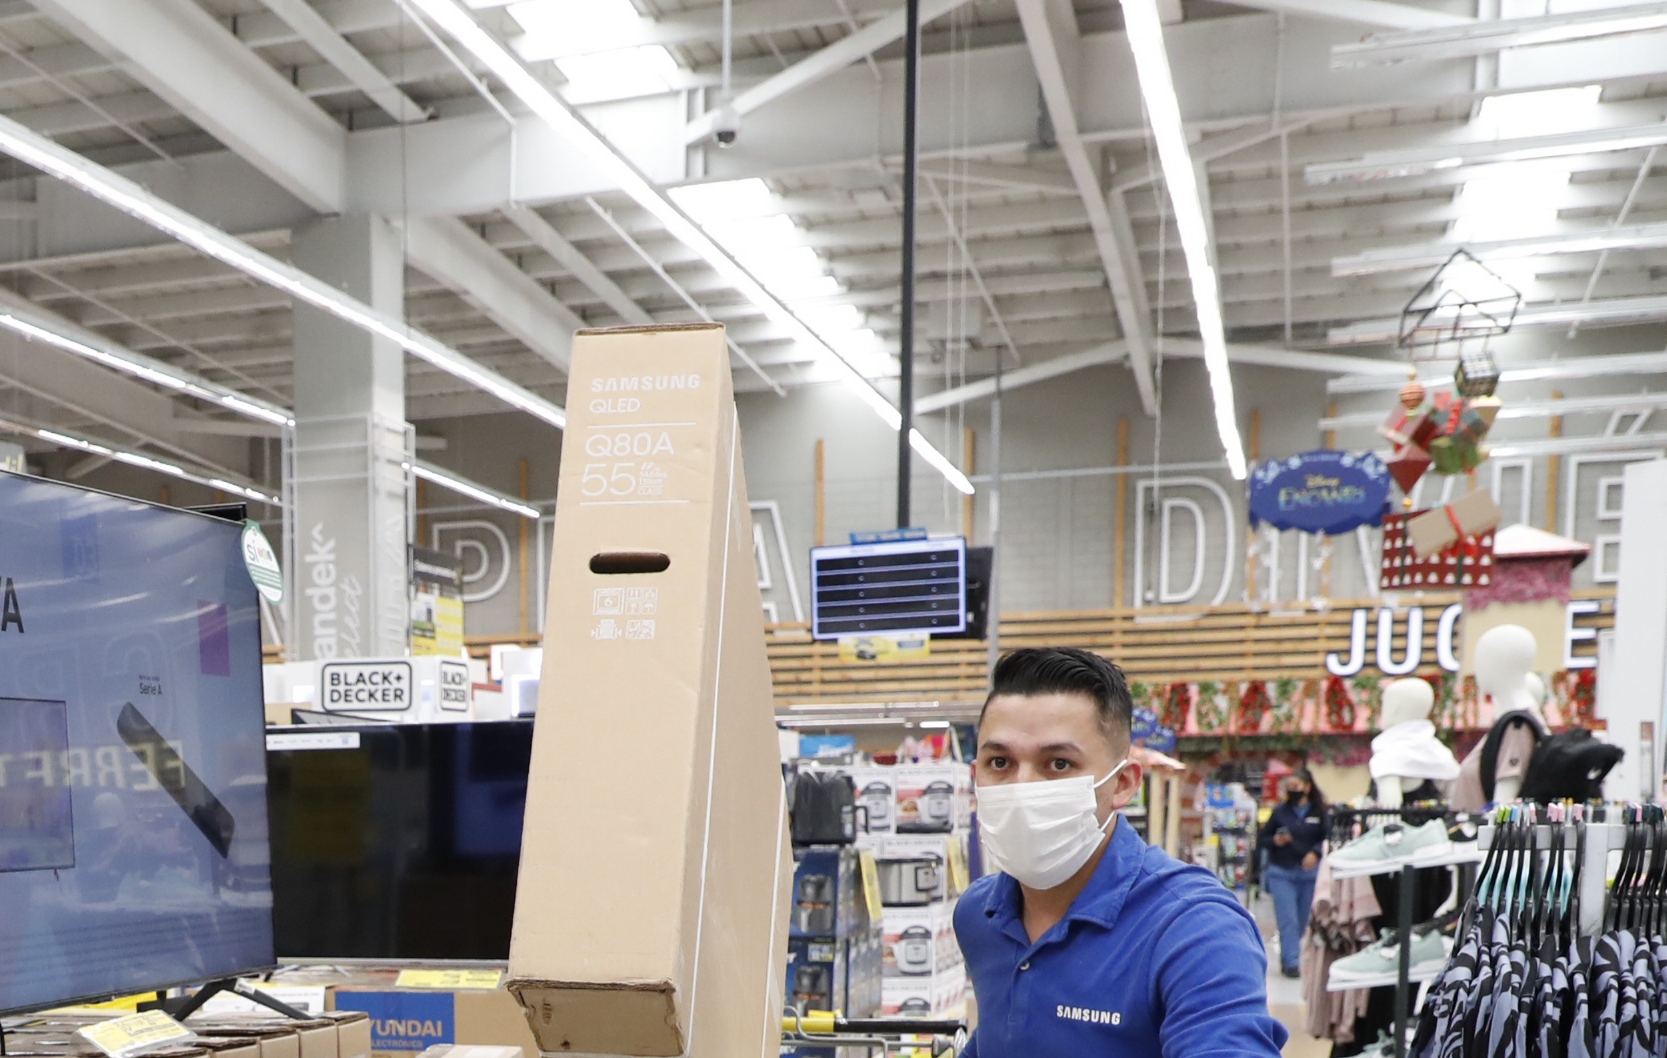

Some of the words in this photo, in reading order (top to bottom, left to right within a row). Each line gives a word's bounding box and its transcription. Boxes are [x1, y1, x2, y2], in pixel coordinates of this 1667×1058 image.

[590, 374, 701, 393] SAMSUNG
[589, 398, 641, 414] QLED
[585, 432, 675, 458] Q80A
[330, 671, 404, 687] BLACK+
[330, 688, 404, 703] DECKER
[1056, 1005, 1121, 1025] SAMSUNG
[371, 1040, 424, 1048] LECTRONICS
